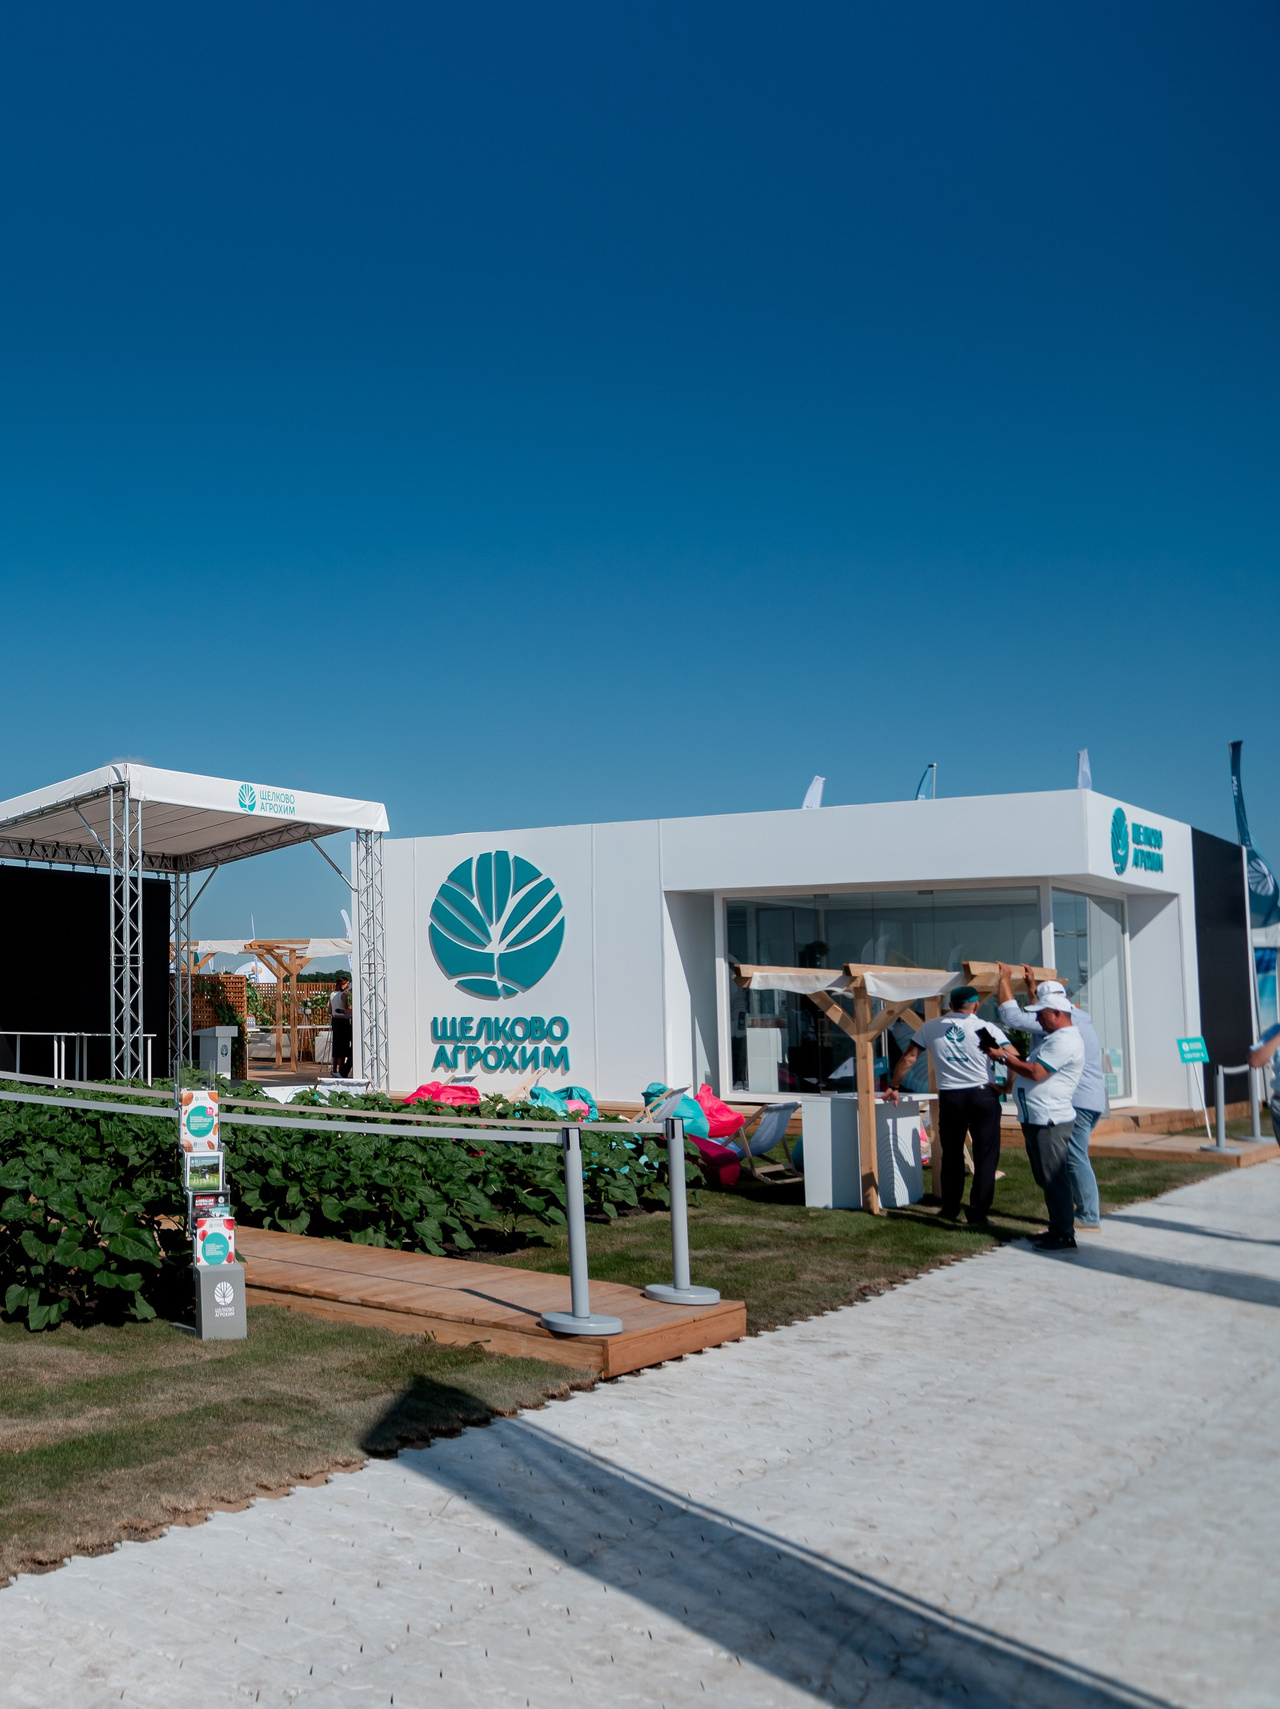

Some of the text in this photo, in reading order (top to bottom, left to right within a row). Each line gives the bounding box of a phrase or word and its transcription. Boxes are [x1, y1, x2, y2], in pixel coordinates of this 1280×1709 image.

[260, 789, 296, 805] ЩЕЛКОВО
[260, 801, 296, 816] АГРОХИМ
[432, 1016, 570, 1042] ЩЕЛКОВО
[433, 1045, 570, 1071] АГРОХИМ
